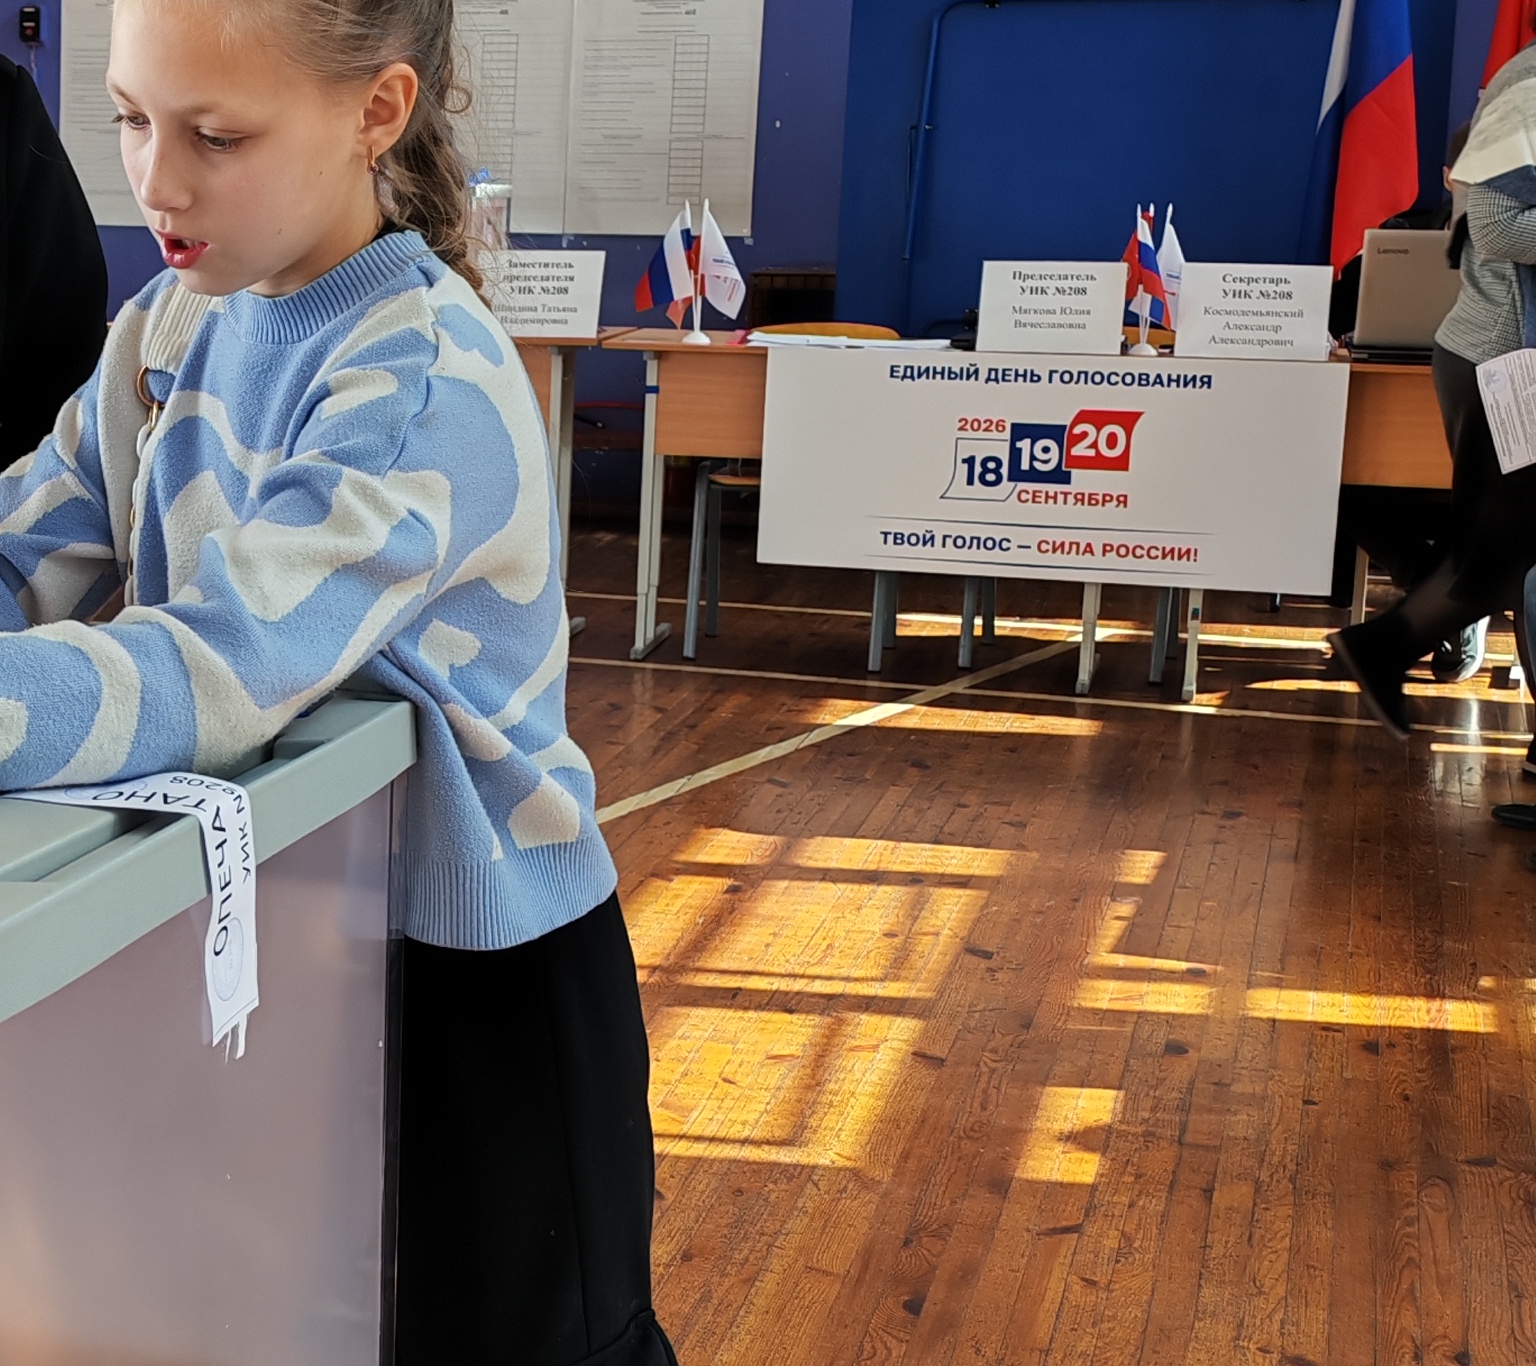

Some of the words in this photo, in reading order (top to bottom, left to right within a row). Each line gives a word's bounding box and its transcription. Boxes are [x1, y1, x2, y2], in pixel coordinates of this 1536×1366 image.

[1012, 270, 1096, 283] Председатель
[1222, 273, 1291, 286] Секретарь
[509, 286, 535, 295] УИК
[538, 286, 569, 295] №208
[1019, 285, 1050, 297] УИК
[1052, 285, 1087, 297] №208
[1222, 289, 1253, 300] УИК
[1256, 289, 1293, 301] №208
[1203, 306, 1303, 319] Космодемьянский
[1222, 321, 1282, 334] Александр
[1208, 335, 1294, 348] Александрович
[889, 362, 980, 385] ЕДИНЫЙ
[984, 367, 1040, 387] ДЕНЬ
[1047, 368, 1213, 390] ГОЛОСОВАНИЯ
[957, 418, 1007, 433] 2026
[961, 454, 1004, 488] 18
[1015, 437, 1060, 472] 19
[1070, 422, 1127, 458] 20
[1016, 488, 1129, 509] СЕНТЯБРЯ
[880, 528, 935, 550] ТВОЙ
[940, 533, 1012, 552] ГОЛОС
[1036, 537, 1094, 558] СИЛА
[1101, 541, 1199, 563] РОССИИ!
